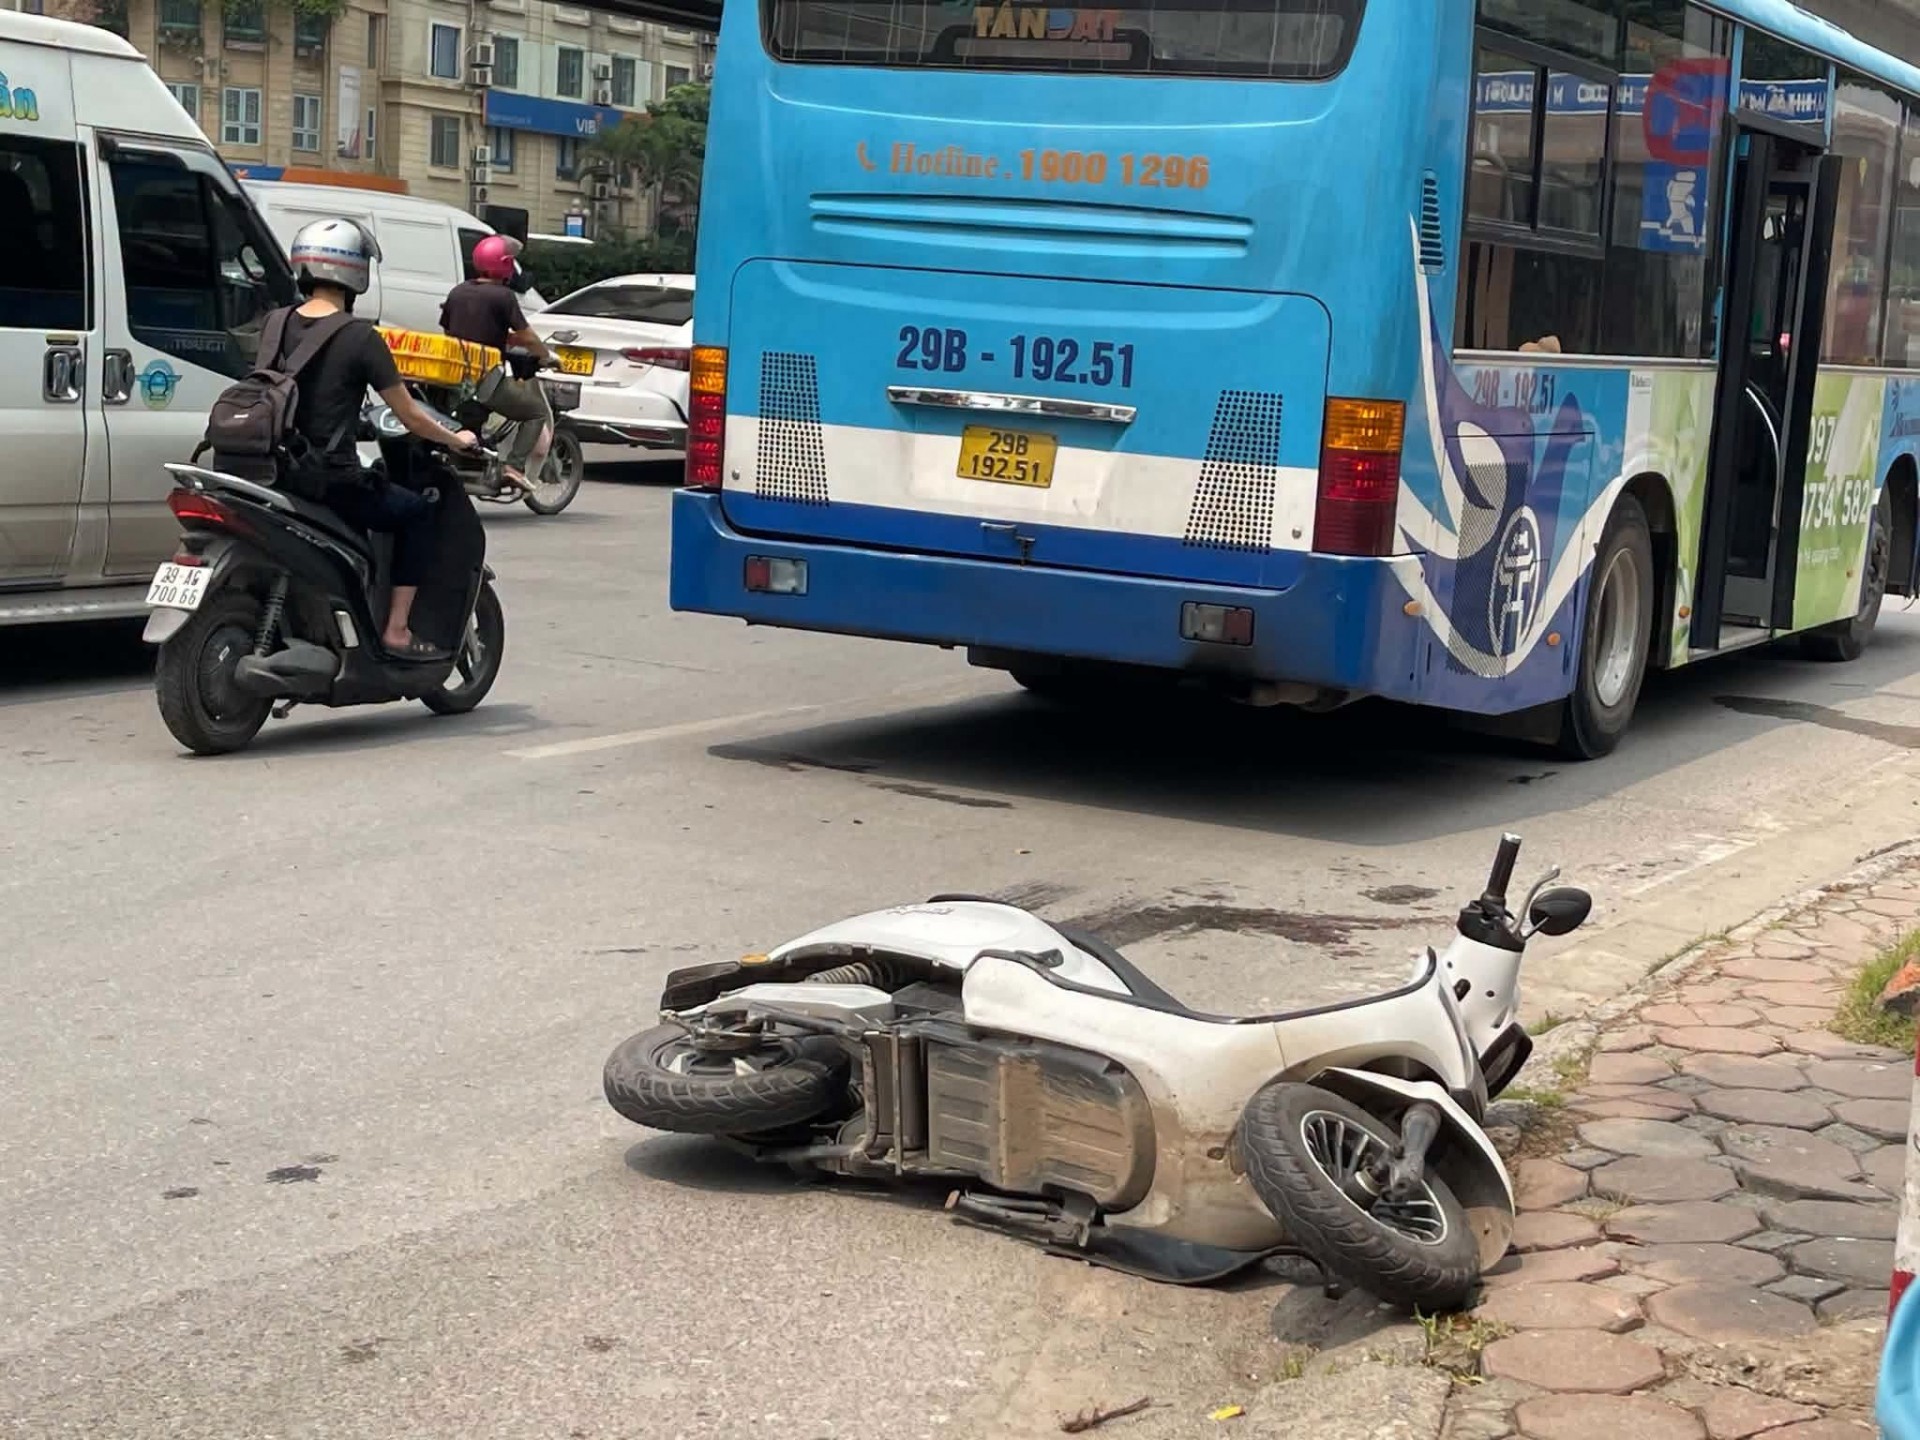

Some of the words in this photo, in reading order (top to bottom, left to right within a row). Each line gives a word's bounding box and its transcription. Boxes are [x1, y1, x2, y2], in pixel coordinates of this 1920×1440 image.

[576, 118, 597, 134] VIB
[1020, 149, 1107, 184] 1900
[1120, 151, 1209, 188] 1296
[896, 325, 967, 373] 29B
[1010, 335, 1135, 388] 192.51
[1474, 369, 1499, 408] 29B
[1514, 372, 1555, 414] 192.51
[987, 431, 1029, 456] 29B
[971, 454, 1041, 484] 192.51
[1841, 479, 1870, 527] 582
